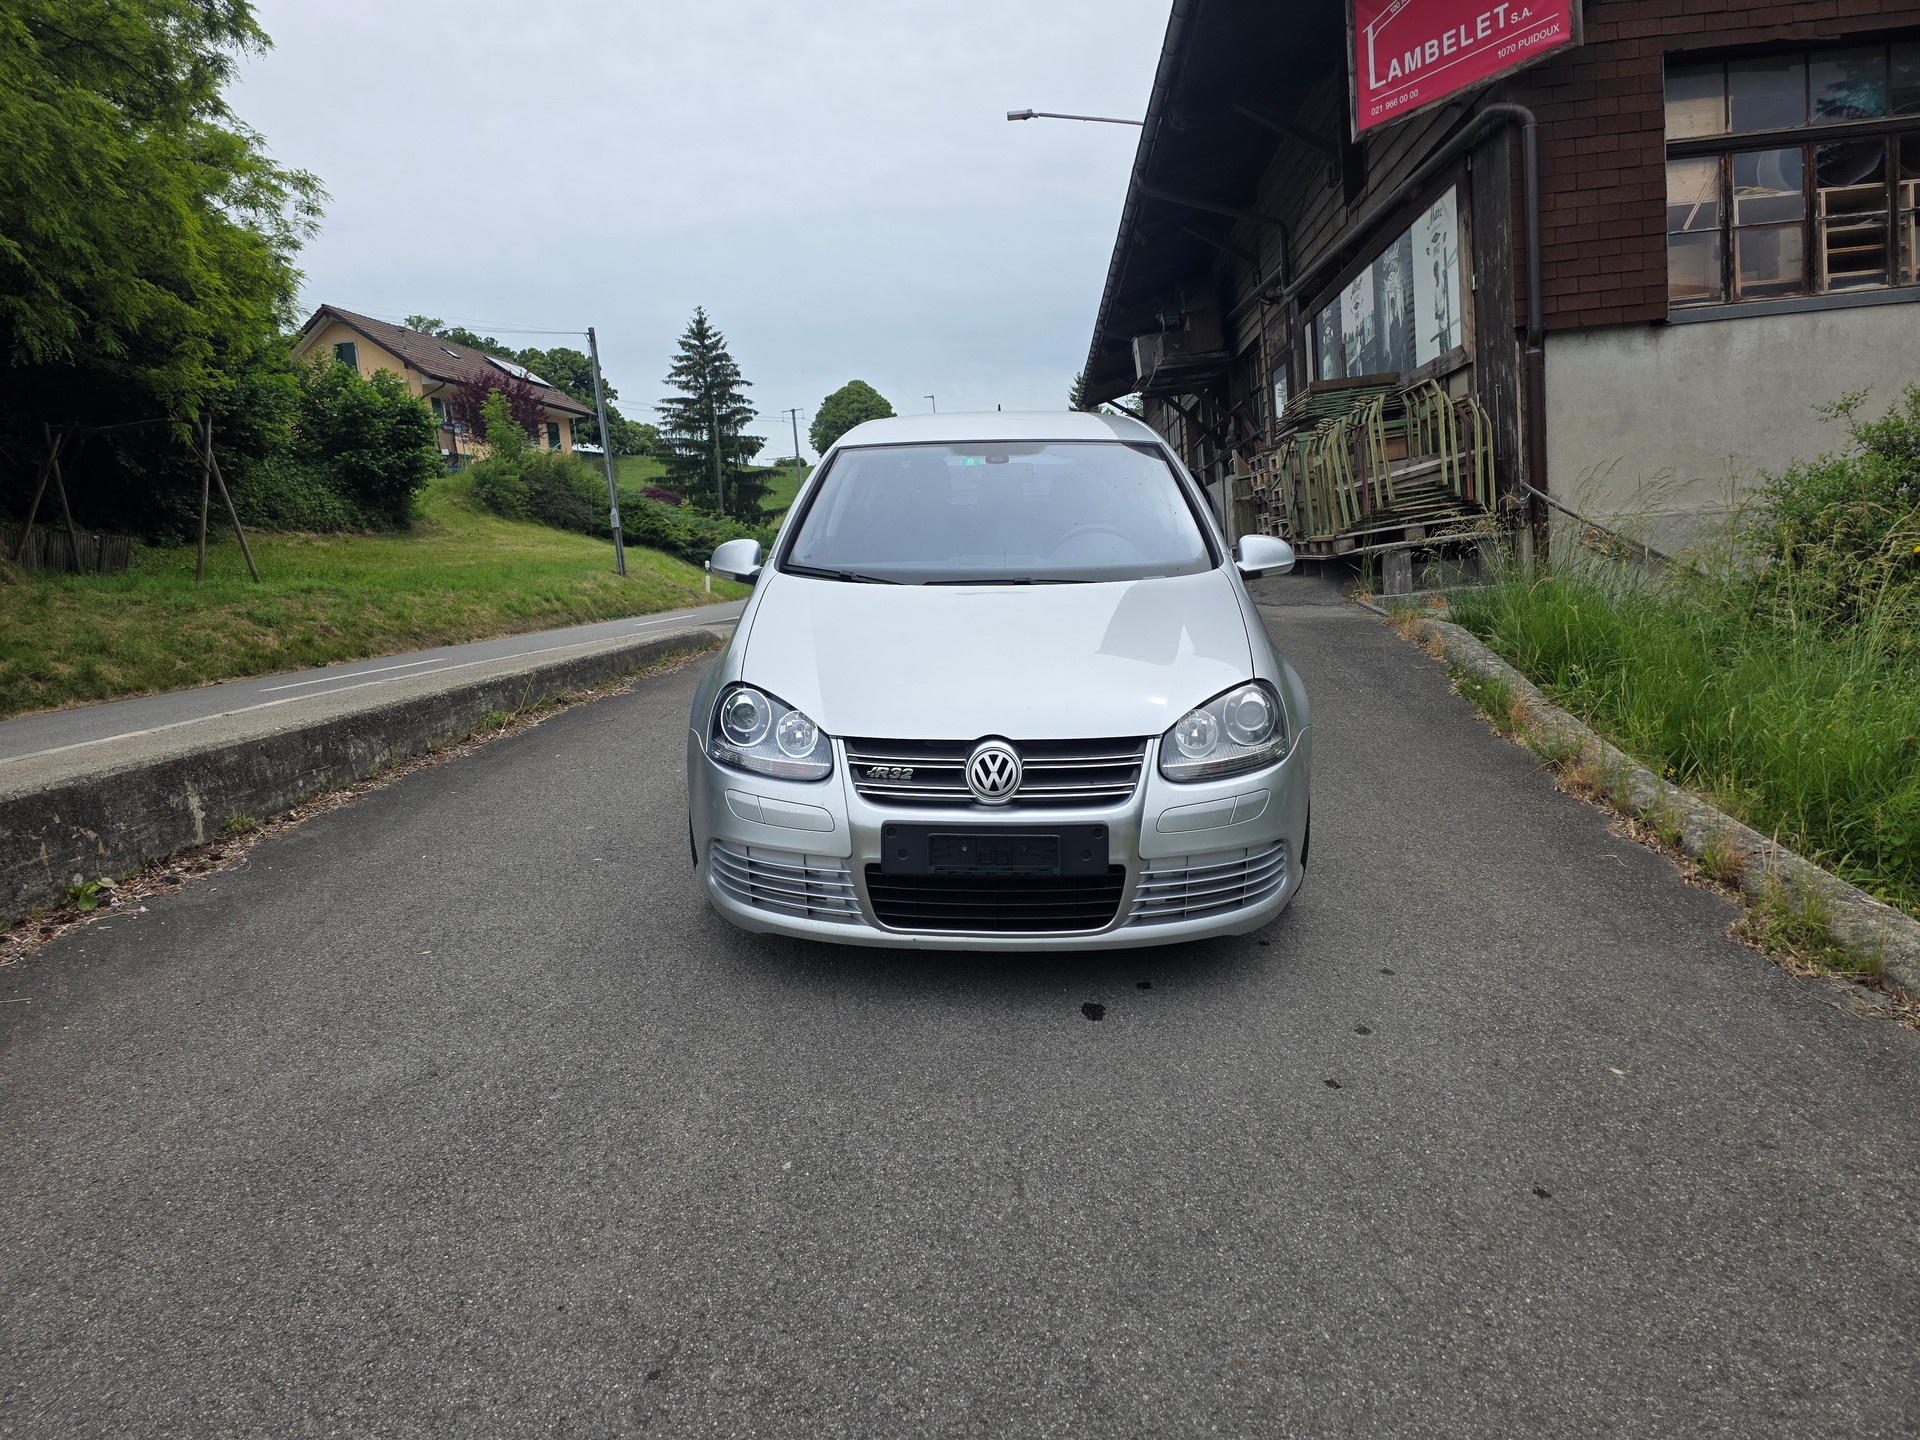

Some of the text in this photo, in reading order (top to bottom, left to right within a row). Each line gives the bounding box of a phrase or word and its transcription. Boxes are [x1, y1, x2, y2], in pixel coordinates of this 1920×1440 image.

[1390, 1, 1401, 14] 100
[1367, 2, 1533, 90] LAMBELET S.A.
[1497, 23, 1560, 59] 1070 PUIDOUX
[1370, 88, 1419, 116] 021 966 00 00
